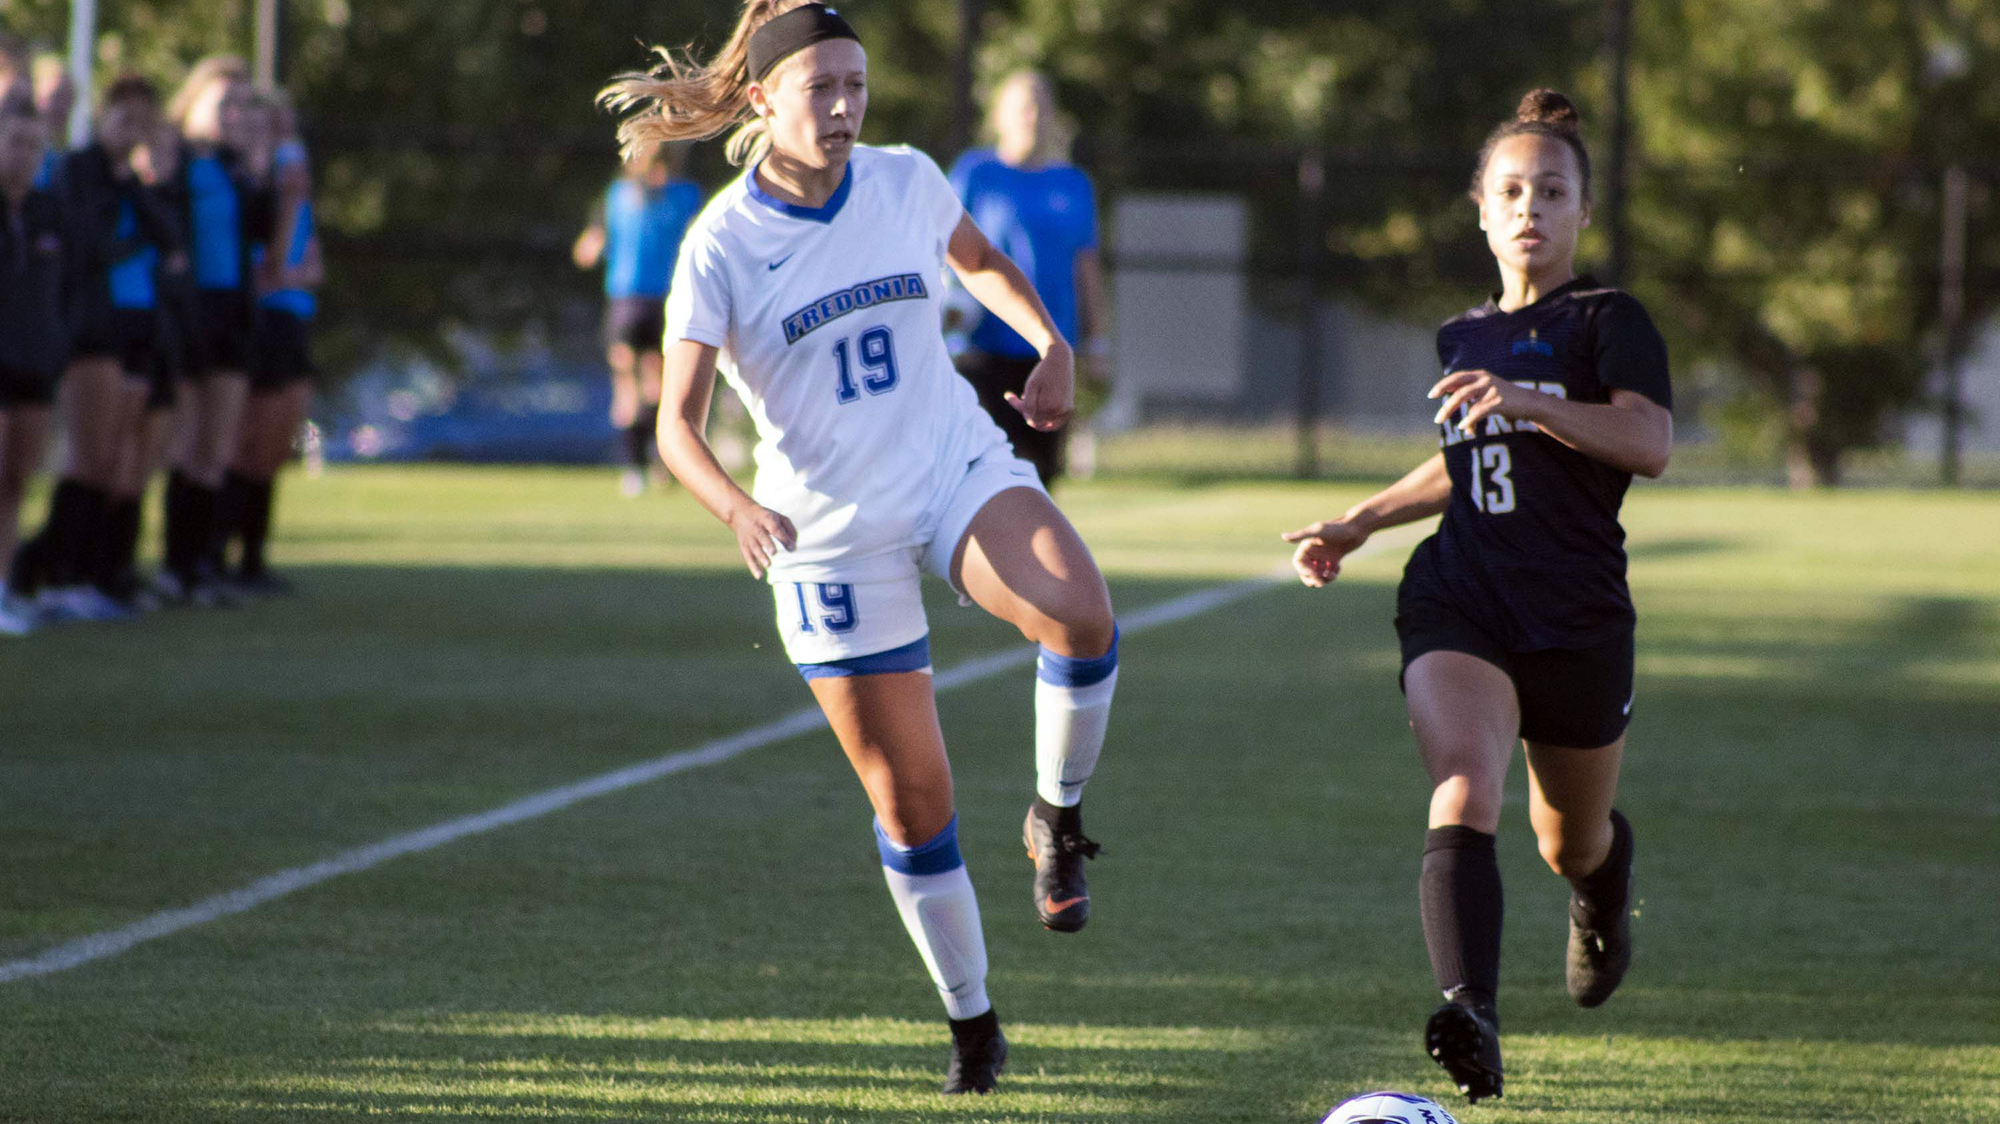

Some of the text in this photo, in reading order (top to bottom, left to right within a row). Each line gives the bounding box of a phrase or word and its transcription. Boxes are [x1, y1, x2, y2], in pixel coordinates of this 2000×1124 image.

[782, 273, 928, 345] FREDONIA
[833, 325, 900, 405] 19
[1471, 444, 1516, 514] 13
[793, 582, 859, 636] 19
